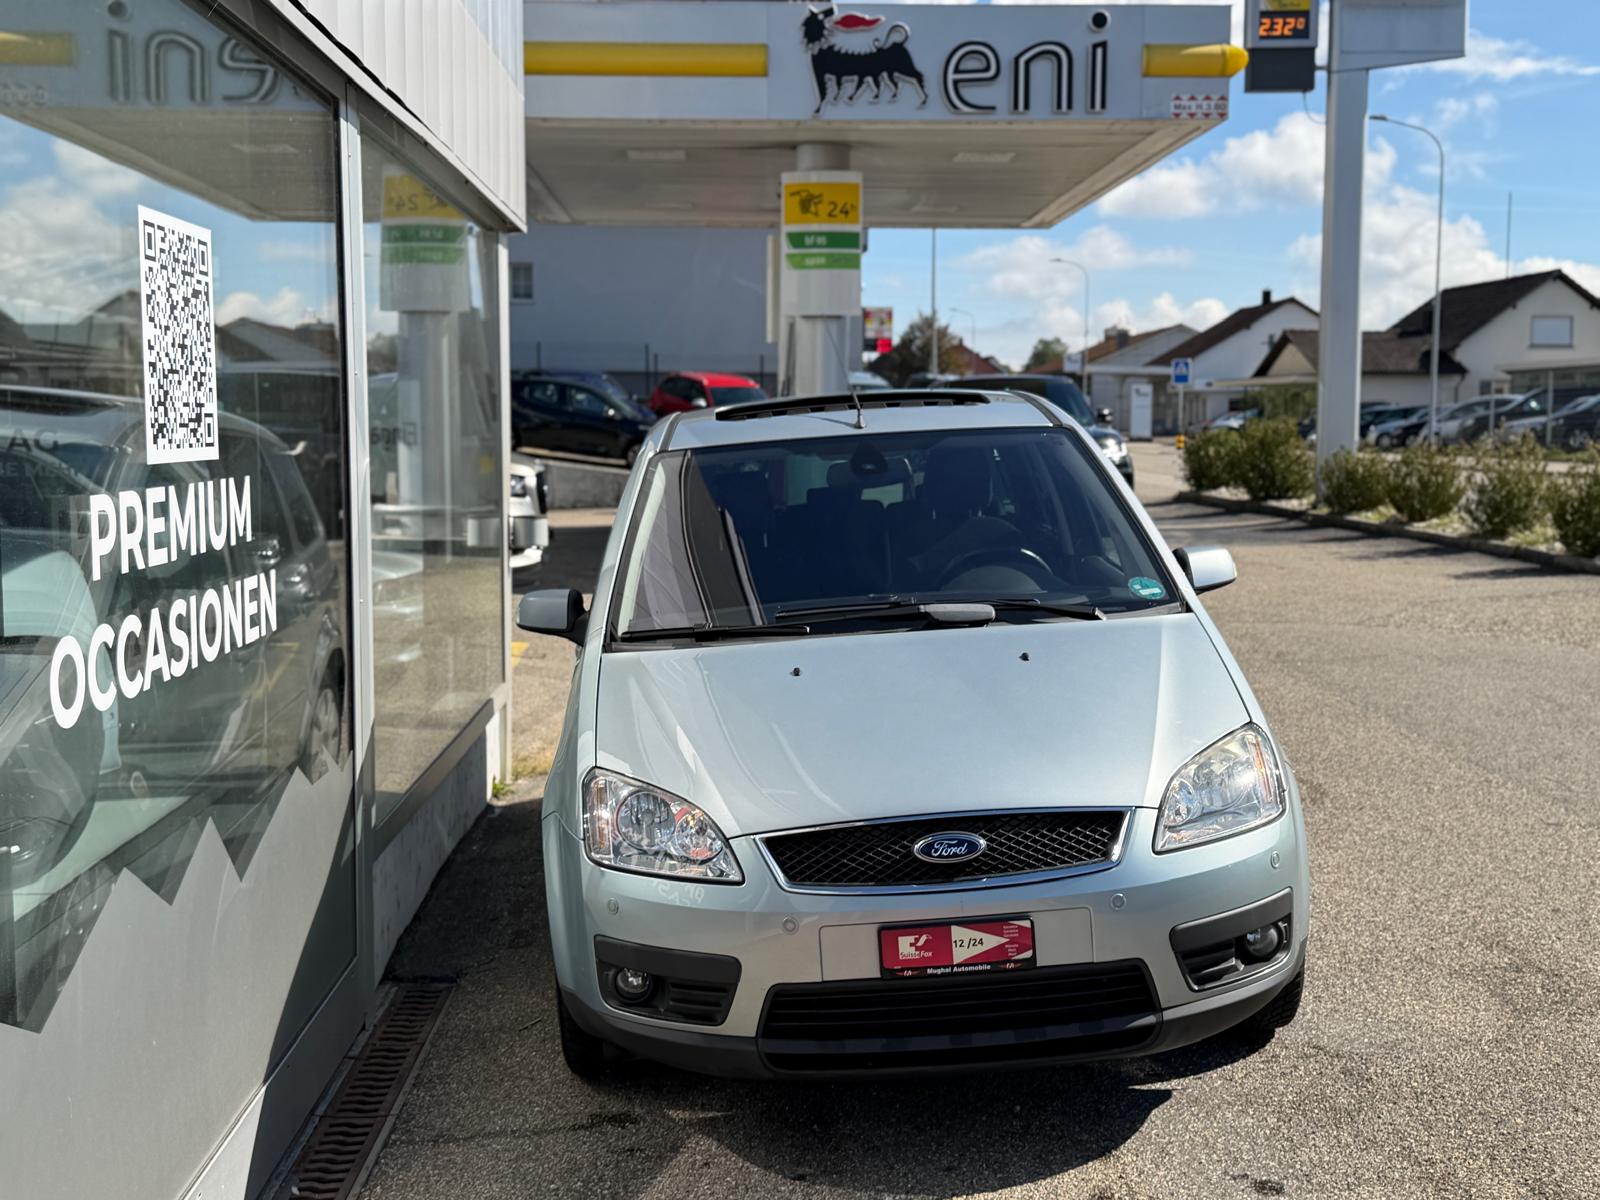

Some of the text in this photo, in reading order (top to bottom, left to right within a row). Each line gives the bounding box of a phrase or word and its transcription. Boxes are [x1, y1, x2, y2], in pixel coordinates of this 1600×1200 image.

[943, 10, 1111, 112] eni
[89, 475, 252, 581] PREMIUM
[49, 568, 278, 729] OCCASIONEN
[931, 840, 968, 857] Ford
[926, 964, 991, 975] Mughal Automobile
[953, 938, 984, 949] 12 /24
